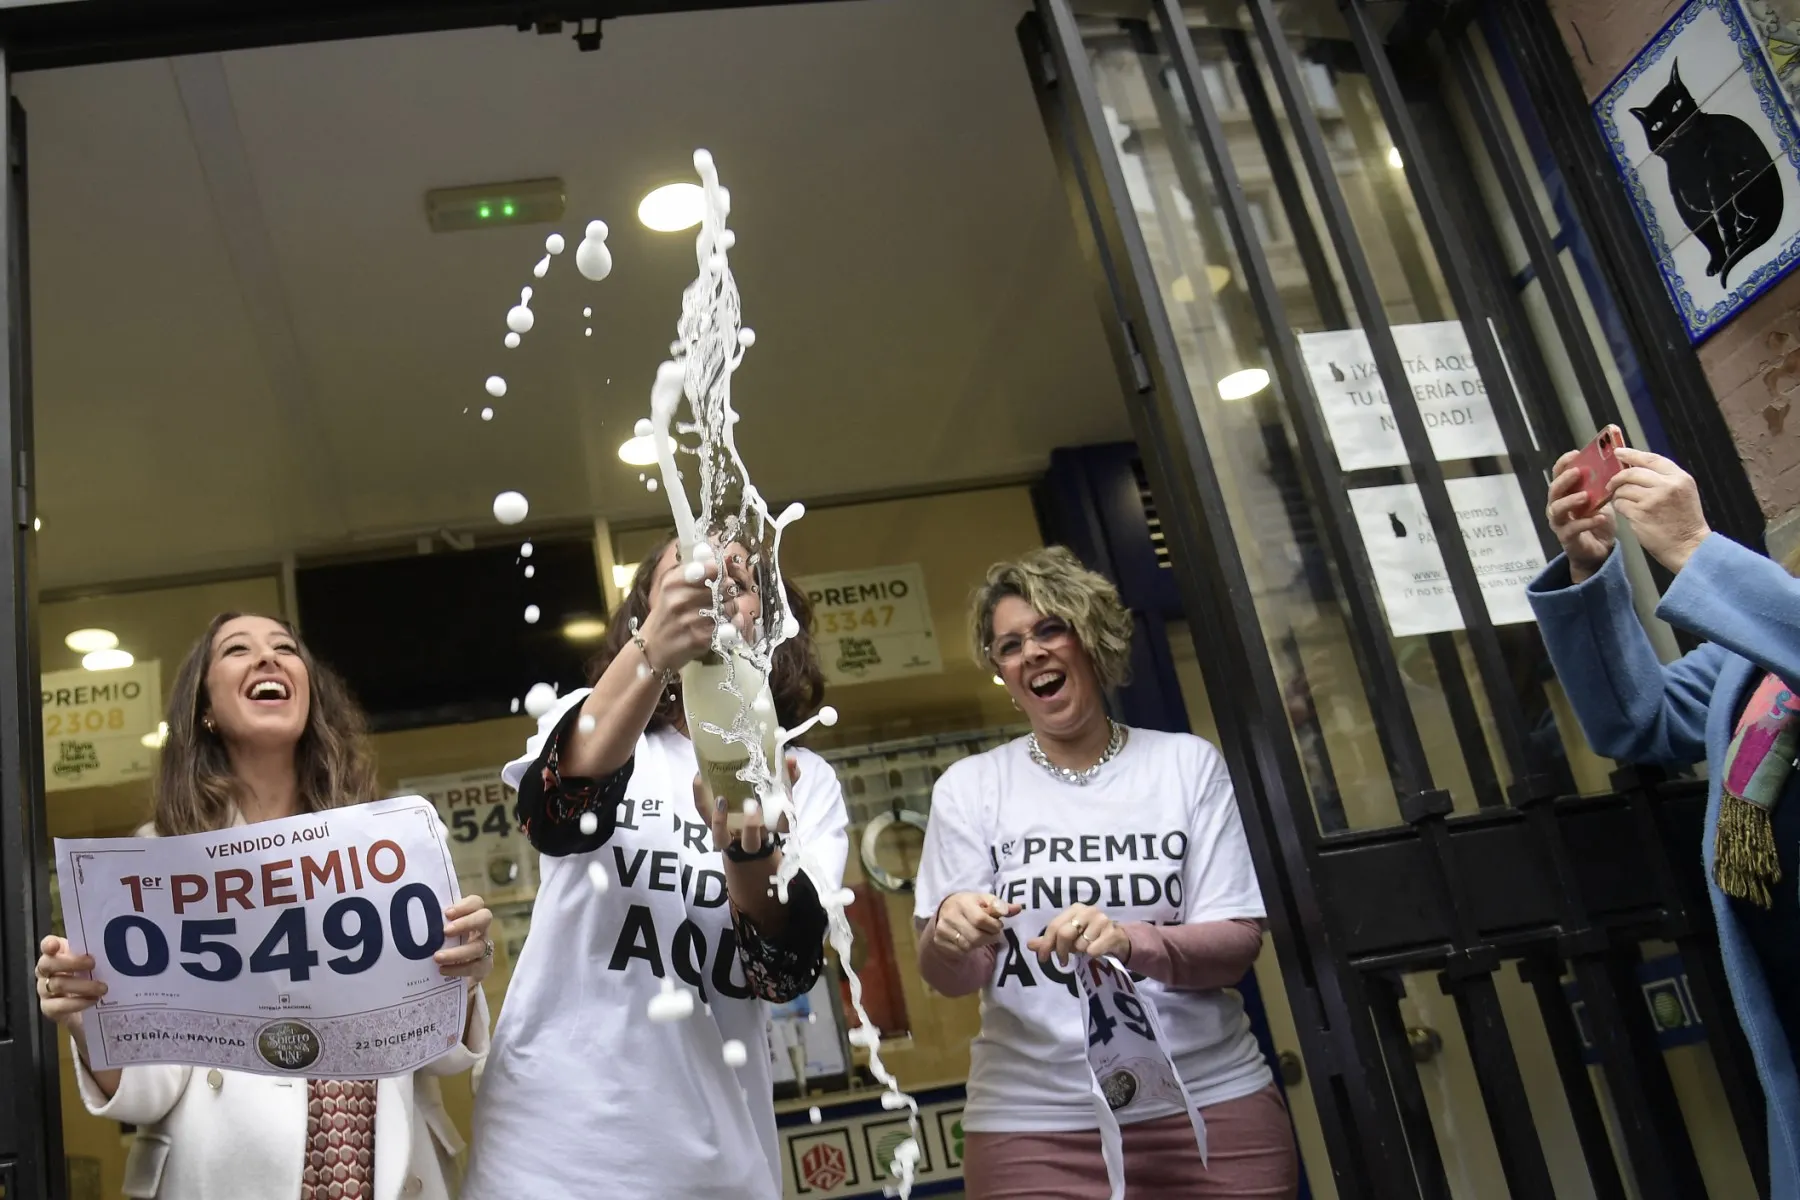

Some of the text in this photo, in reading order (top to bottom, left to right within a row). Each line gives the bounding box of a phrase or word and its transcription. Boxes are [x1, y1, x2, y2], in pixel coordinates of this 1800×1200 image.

[1435, 355, 1476, 372] AQU
[1346, 391, 1373, 406] TU
[808, 580, 908, 606] PREMIO
[42, 681, 141, 707] PREMIO
[205, 821, 331, 860] VENDIDO AQUÍ
[1022, 830, 1188, 866] PREMIO
[120, 839, 406, 914] 1er PREMIO
[103, 882, 445, 982] 05490
[607, 903, 756, 1004] AQU
[407, 977, 430, 987] SEVILLA
[116, 1031, 169, 1042] LOTERÍA
[187, 1035, 246, 1047] NAVIDAD
[355, 1023, 436, 1050] 22 DICIEMBRE
